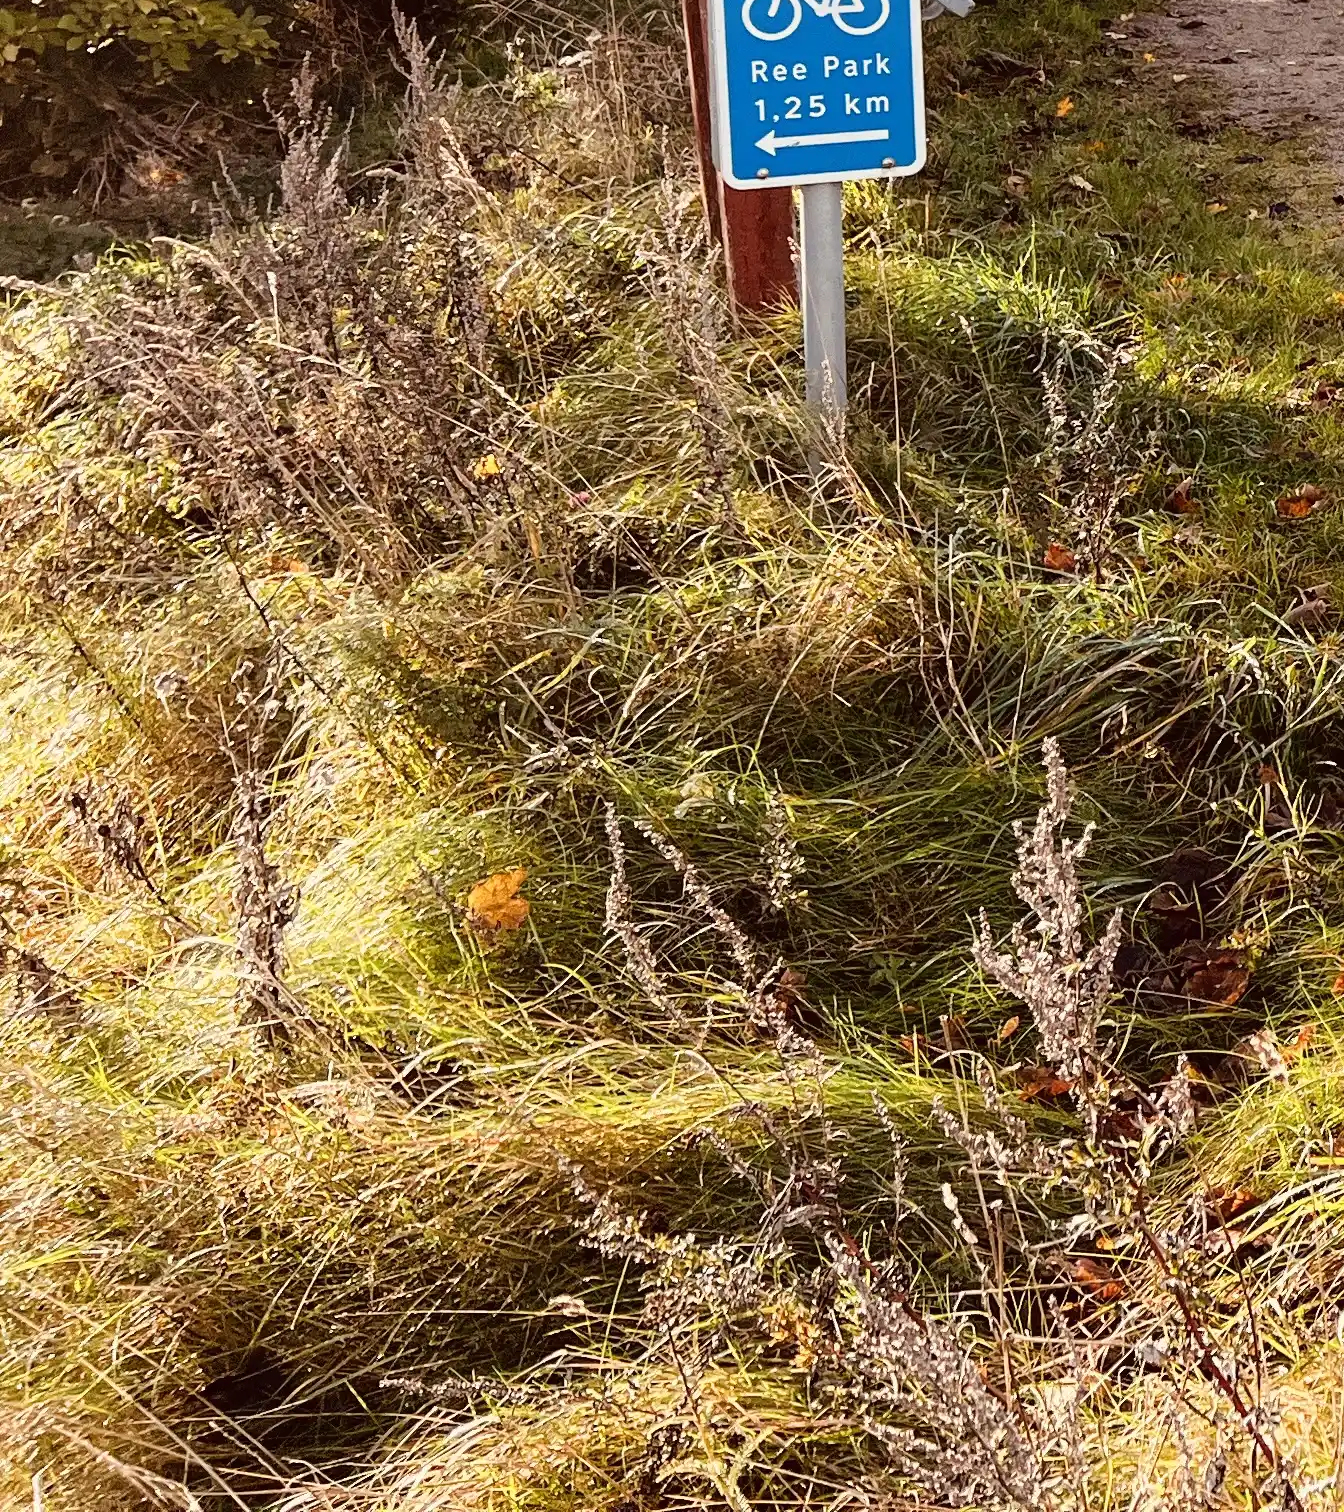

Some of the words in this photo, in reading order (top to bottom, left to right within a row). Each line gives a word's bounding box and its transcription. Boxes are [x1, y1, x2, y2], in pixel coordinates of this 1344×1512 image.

[751, 59, 808, 83] Ree
[823, 52, 891, 78] Park
[754, 94, 827, 123] 1,25
[844, 93, 890, 115] km
